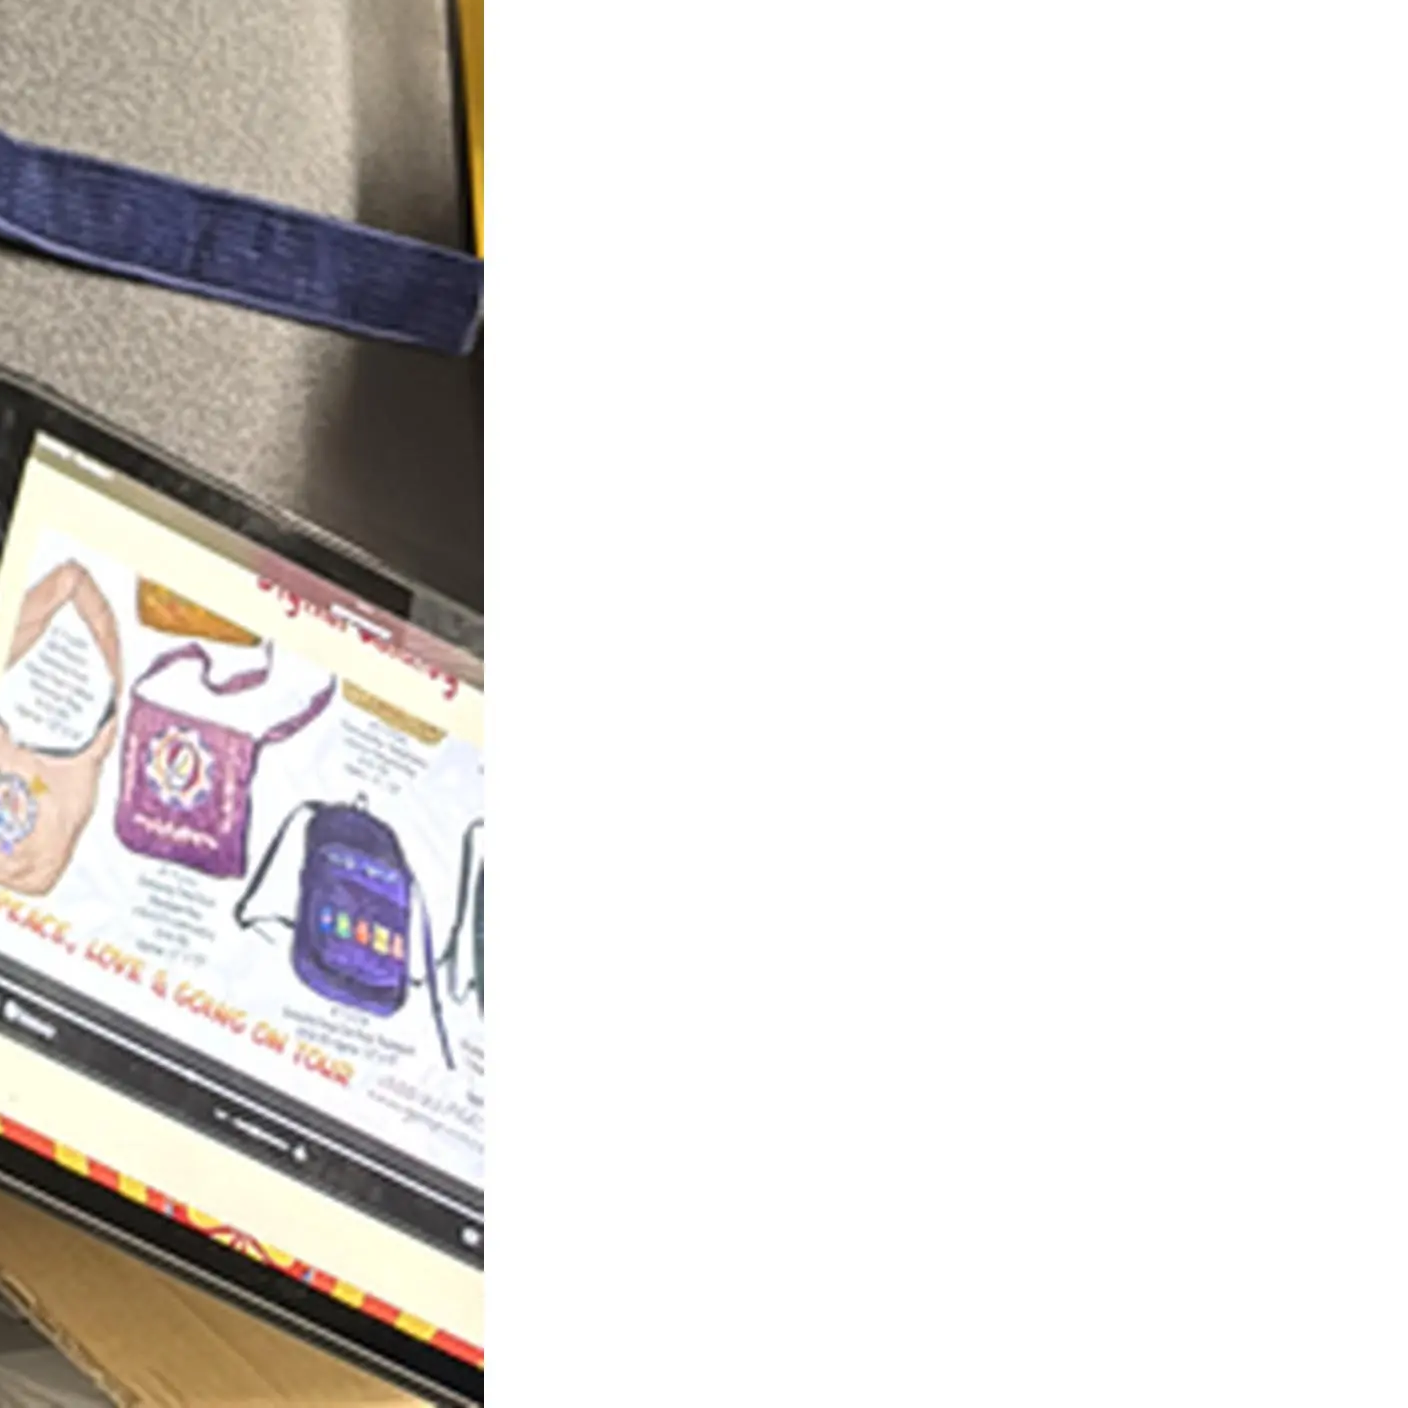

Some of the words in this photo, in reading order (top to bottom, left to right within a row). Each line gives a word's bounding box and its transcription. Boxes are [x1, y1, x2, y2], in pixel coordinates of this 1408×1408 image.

[85, 939, 145, 985] LOVE
[251, 1021, 289, 1055] ON
[293, 1041, 355, 1088] TOUR
